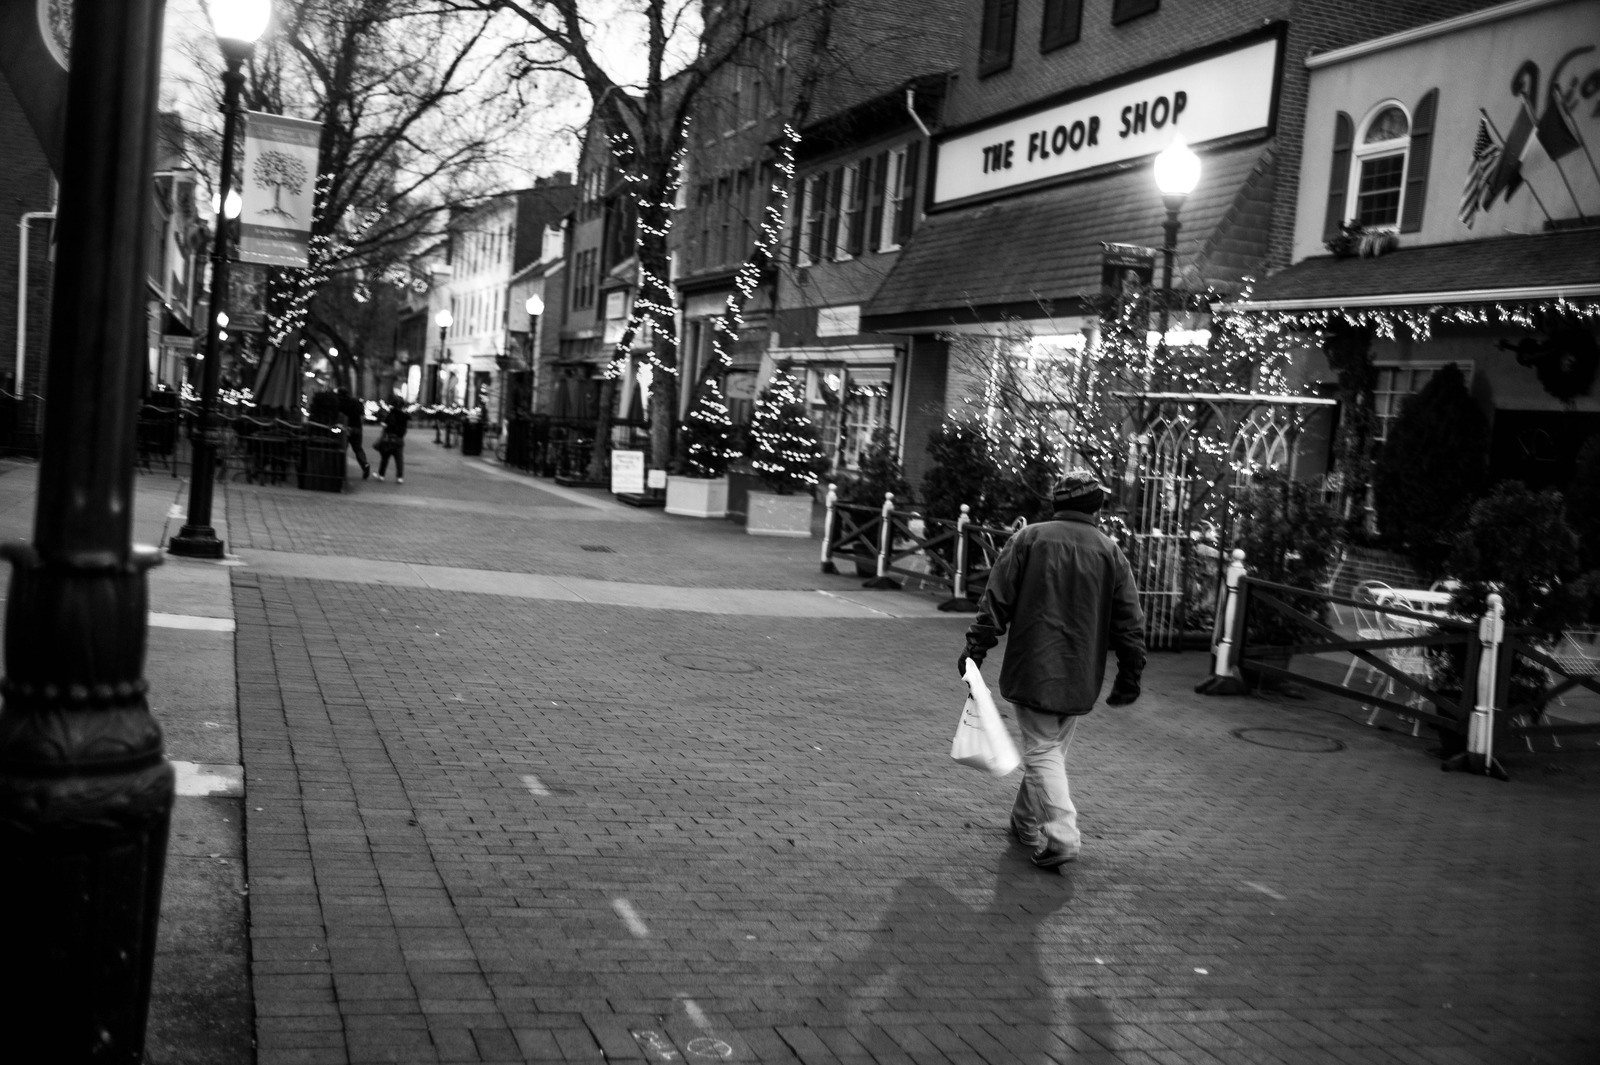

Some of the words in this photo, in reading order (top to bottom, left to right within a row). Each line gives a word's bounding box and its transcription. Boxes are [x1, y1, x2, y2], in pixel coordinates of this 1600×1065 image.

[982, 139, 1015, 174] THE
[1027, 115, 1101, 162] FLOOR
[1119, 90, 1188, 138] SHOP
